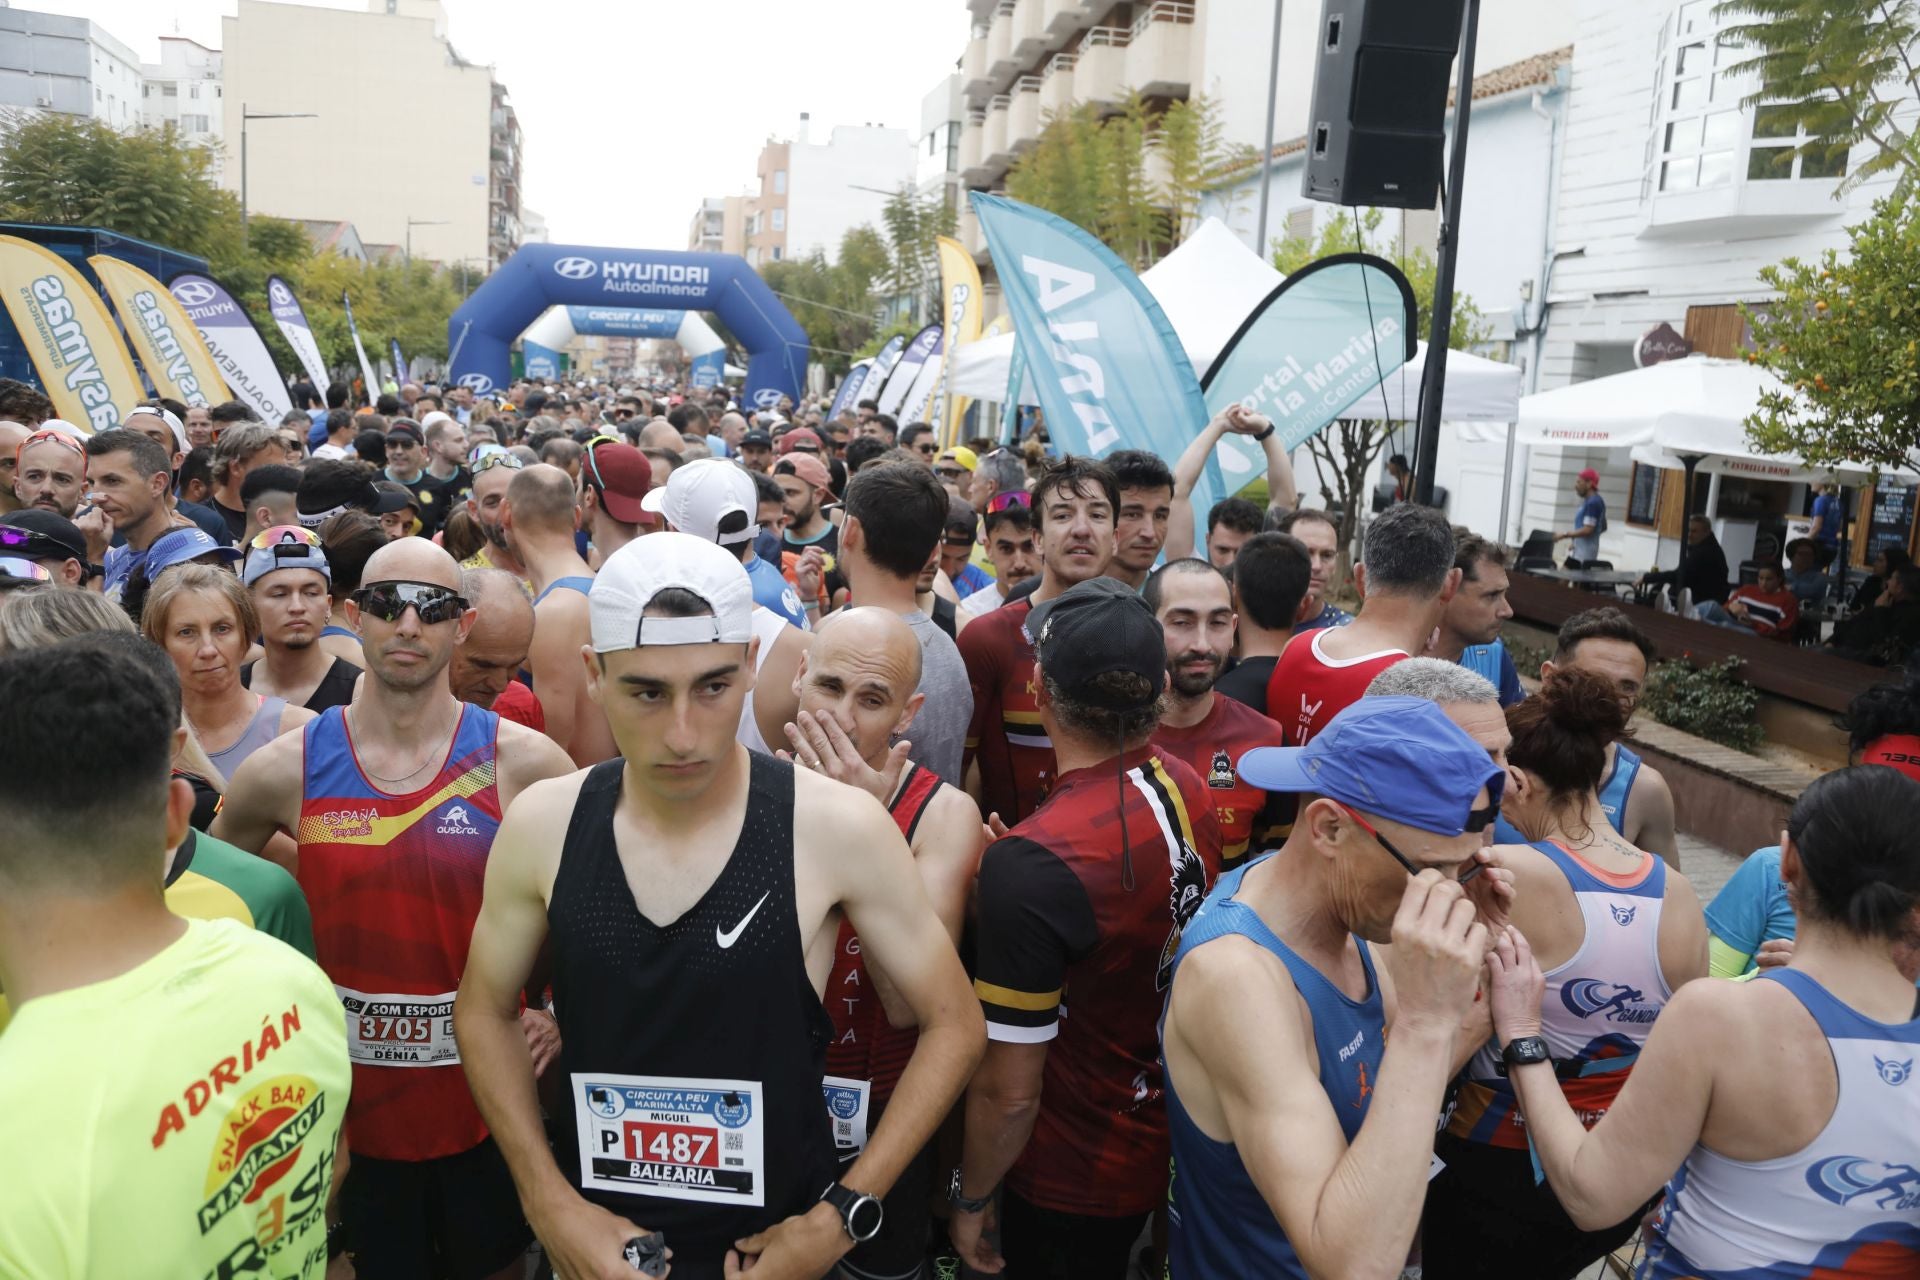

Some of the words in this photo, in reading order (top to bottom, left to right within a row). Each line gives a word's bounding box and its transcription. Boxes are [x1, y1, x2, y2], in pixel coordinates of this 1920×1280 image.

[602, 261, 709, 284] HYUNDAI
[603, 279, 708, 297] Autoalmenar
[588, 310, 632, 322] CIRCUIT
[632, 313, 642, 322] A
[642, 312, 665, 324] PEU
[1273, 390, 1307, 417] la
[1304, 314, 1400, 394] Marina
[1240, 354, 1304, 413] ortal
[1551, 430, 1585, 440] ESTRELLA
[1587, 431, 1610, 440] DAMM
[1731, 460, 1766, 473] ESTRELLA
[1767, 465, 1792, 476] DAMM
[322, 807, 380, 826] ESPAÑA
[331, 826, 373, 839] TRIATLÓN
[437, 825, 480, 836] austral
[371, 1004, 401, 1015] SOM
[405, 1003, 453, 1016] ESPORT
[362, 1017, 428, 1040] 3705
[374, 1048, 419, 1060] DÉNIA
[1339, 1030, 1364, 1062] FASTER
[152, 1004, 301, 1150] ADRIÁN
[626, 1090, 672, 1102] CIRCUIT
[673, 1093, 682, 1101] A
[686, 1093, 710, 1103] PEU
[635, 1101, 674, 1110] MARINA
[679, 1102, 704, 1112] ALTA
[650, 1113, 690, 1123] MIGUEL
[218, 1096, 262, 1174] SNACK
[271, 1086, 305, 1105] BAR
[601, 1129, 619, 1153] P
[631, 1129, 714, 1165] 1487
